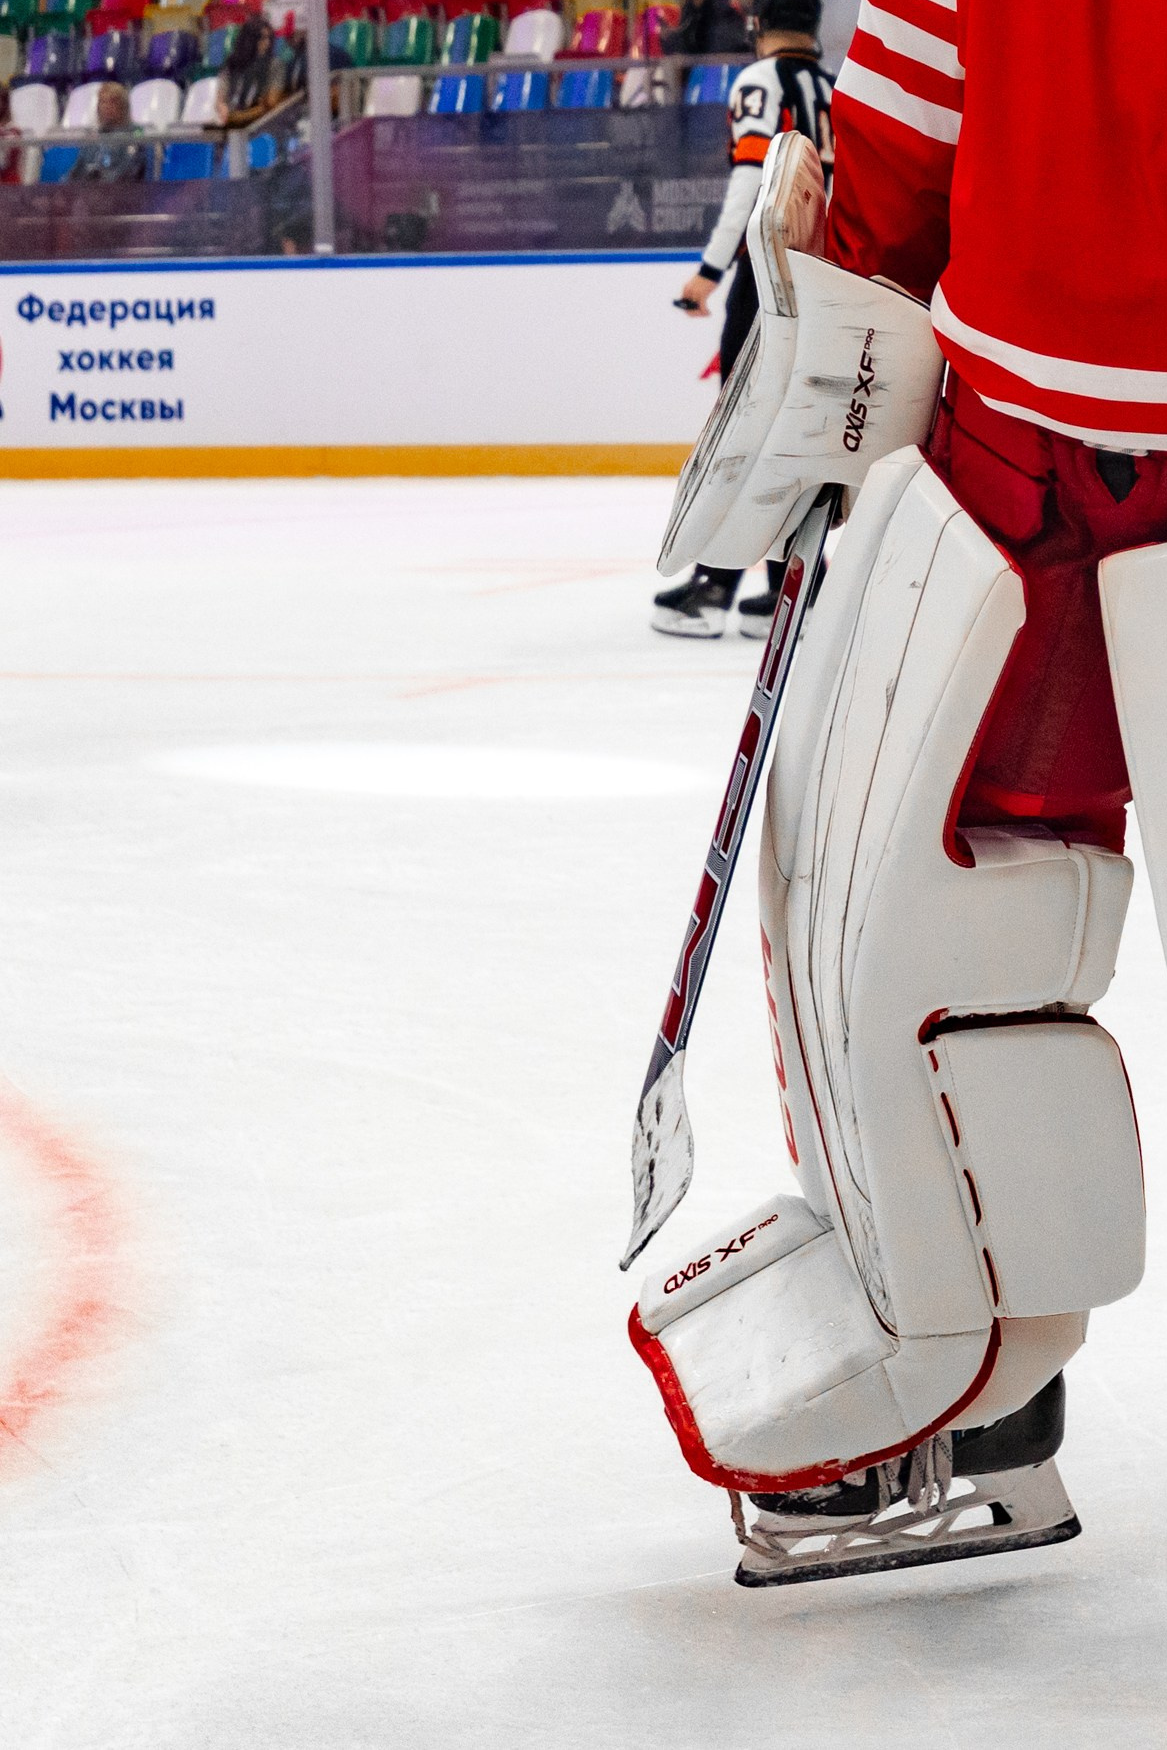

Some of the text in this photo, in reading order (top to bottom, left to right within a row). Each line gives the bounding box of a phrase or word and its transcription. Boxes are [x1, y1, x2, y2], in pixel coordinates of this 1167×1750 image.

[17, 292, 216, 330] Федерация
[864, 327, 875, 350] PRO
[58, 349, 175, 372] хоккея
[49, 391, 184, 421] Москвы
[757, 1213, 779, 1231] PRO
